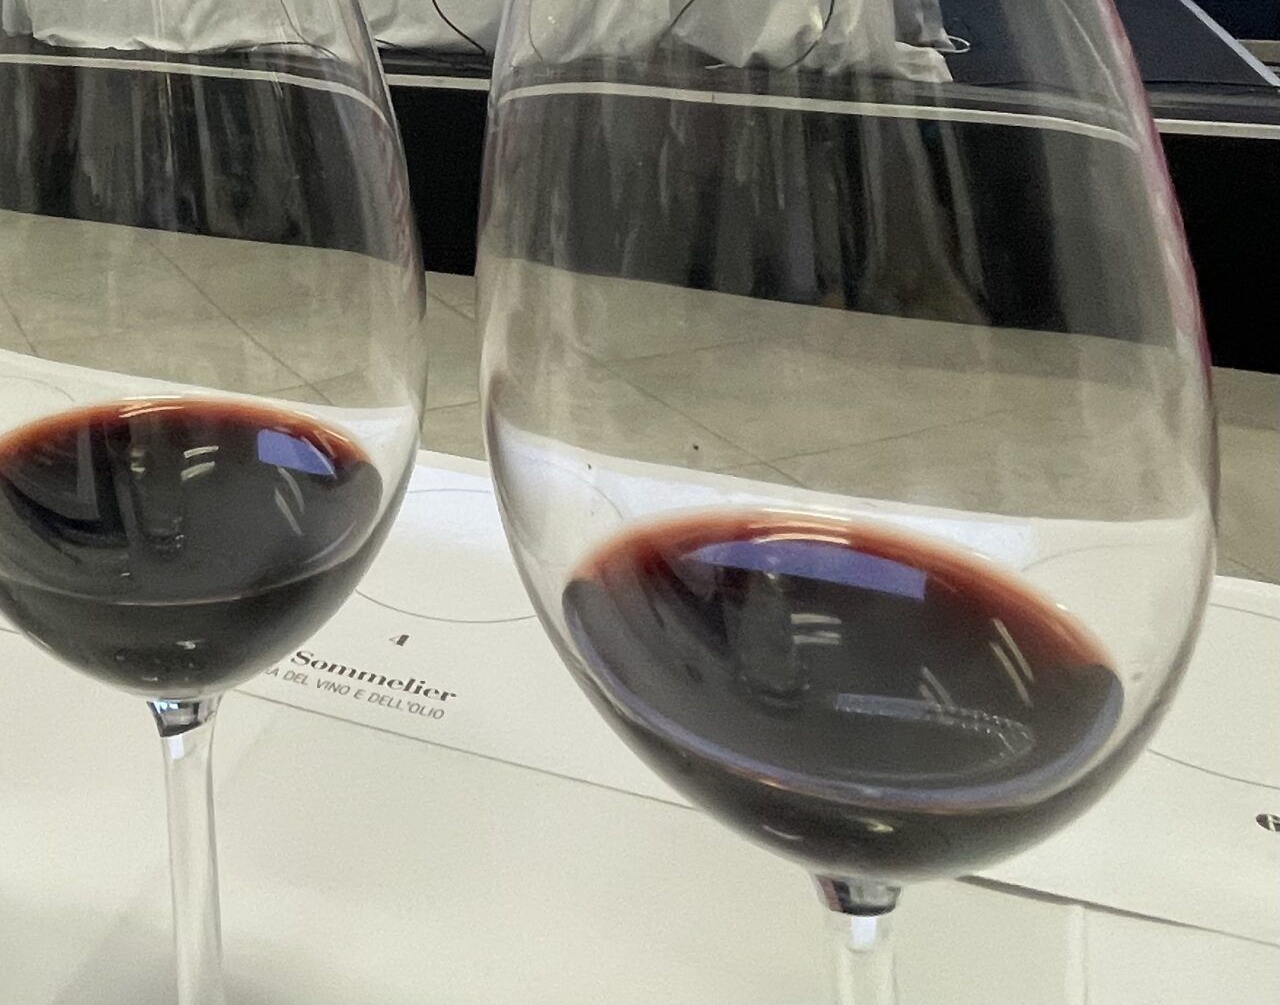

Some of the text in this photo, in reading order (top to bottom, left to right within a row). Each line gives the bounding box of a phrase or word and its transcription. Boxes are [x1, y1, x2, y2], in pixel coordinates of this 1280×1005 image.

[389, 634, 410, 647] 4
[283, 670, 309, 686] DEL
[316, 678, 351, 696] VINO
[353, 688, 366, 700] E
[367, 692, 445, 720] DELL'OLIO
[290, 649, 458, 702] Sommelier
